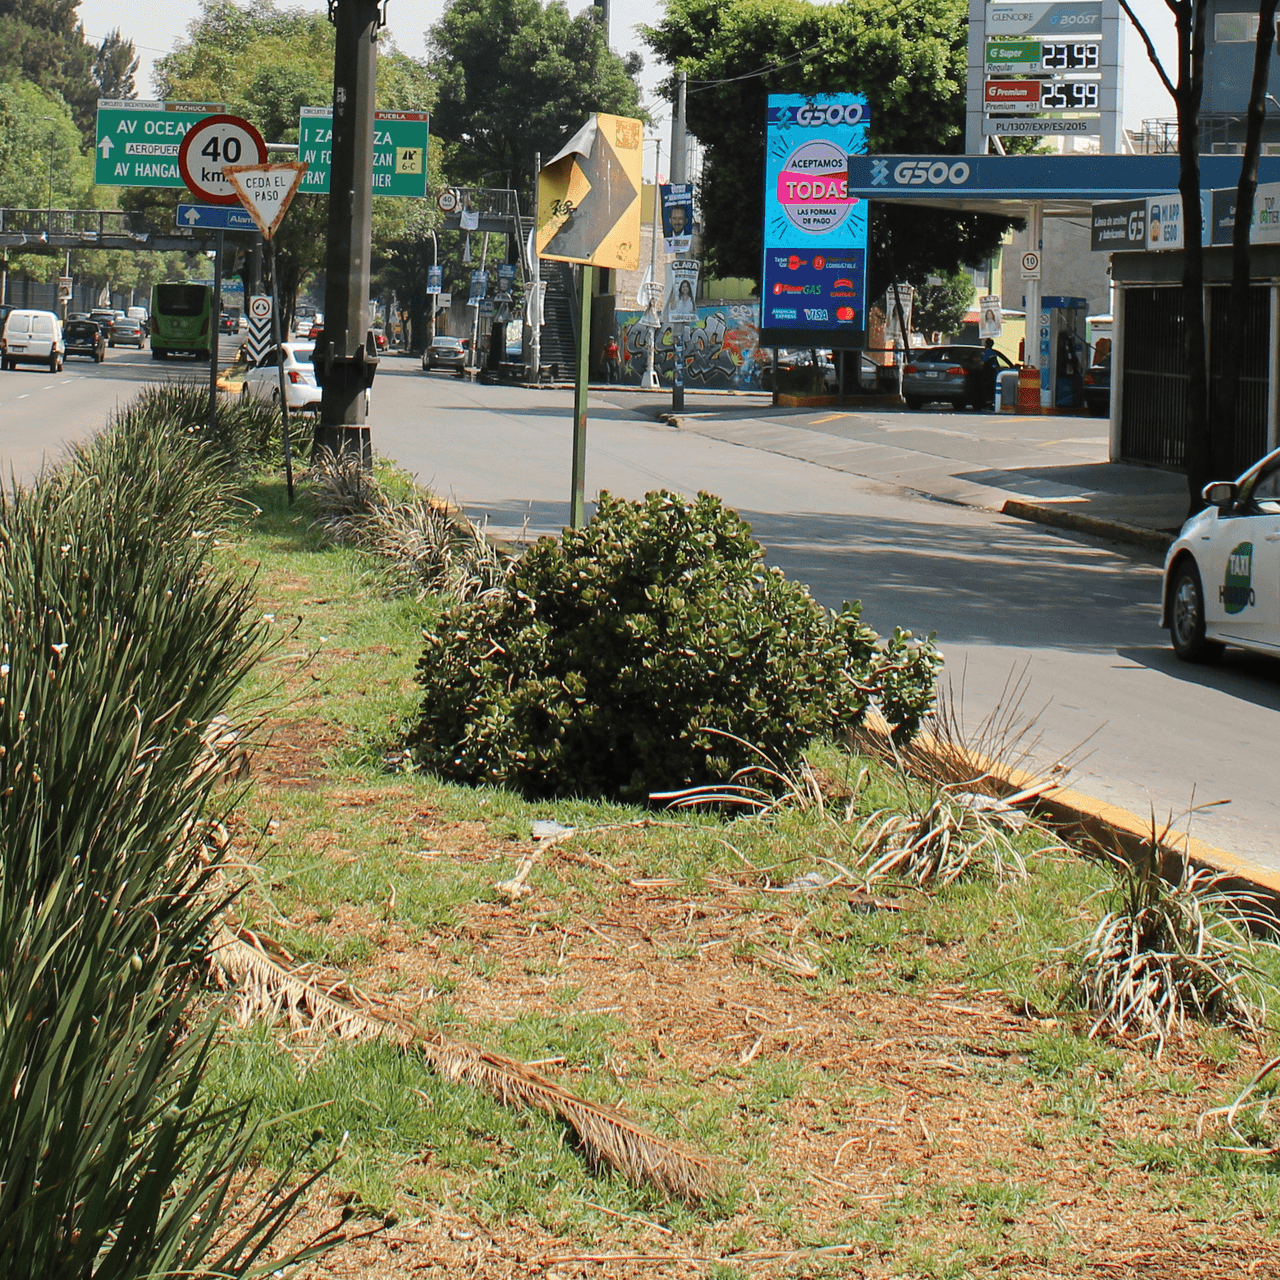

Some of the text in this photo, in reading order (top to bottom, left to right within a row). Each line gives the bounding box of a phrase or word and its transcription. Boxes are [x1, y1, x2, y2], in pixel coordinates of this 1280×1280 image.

[992, 13, 1033, 21] GLENCORE
[999, 49, 1023, 58] Super
[1042, 44, 1099, 69] 23.99
[987, 64, 1014, 72] Regular
[997, 89, 1028, 97] Premium
[1042, 84, 1099, 108] 25.99
[797, 103, 863, 126] G500
[116, 120, 138, 134] AV
[996, 122, 1087, 131] PL/1307/EXP/ES/2015
[201, 136, 242, 163] 40
[304, 150, 317, 163] AV
[114, 163, 130, 176] AV
[791, 159, 843, 168] ACEPTAMOS
[201, 167, 229, 182] km
[894, 161, 970, 184] G500
[246, 176, 286, 188] CEDA EL
[255, 190, 279, 201] PASO
[786, 181, 848, 199] TODAS
[672, 261, 698, 270] CLARA
[1026, 257, 1034, 265] 10
[803, 285, 821, 295] GAS
[804, 309, 828, 320] VISA
[1230, 554, 1249, 576] TAXI
